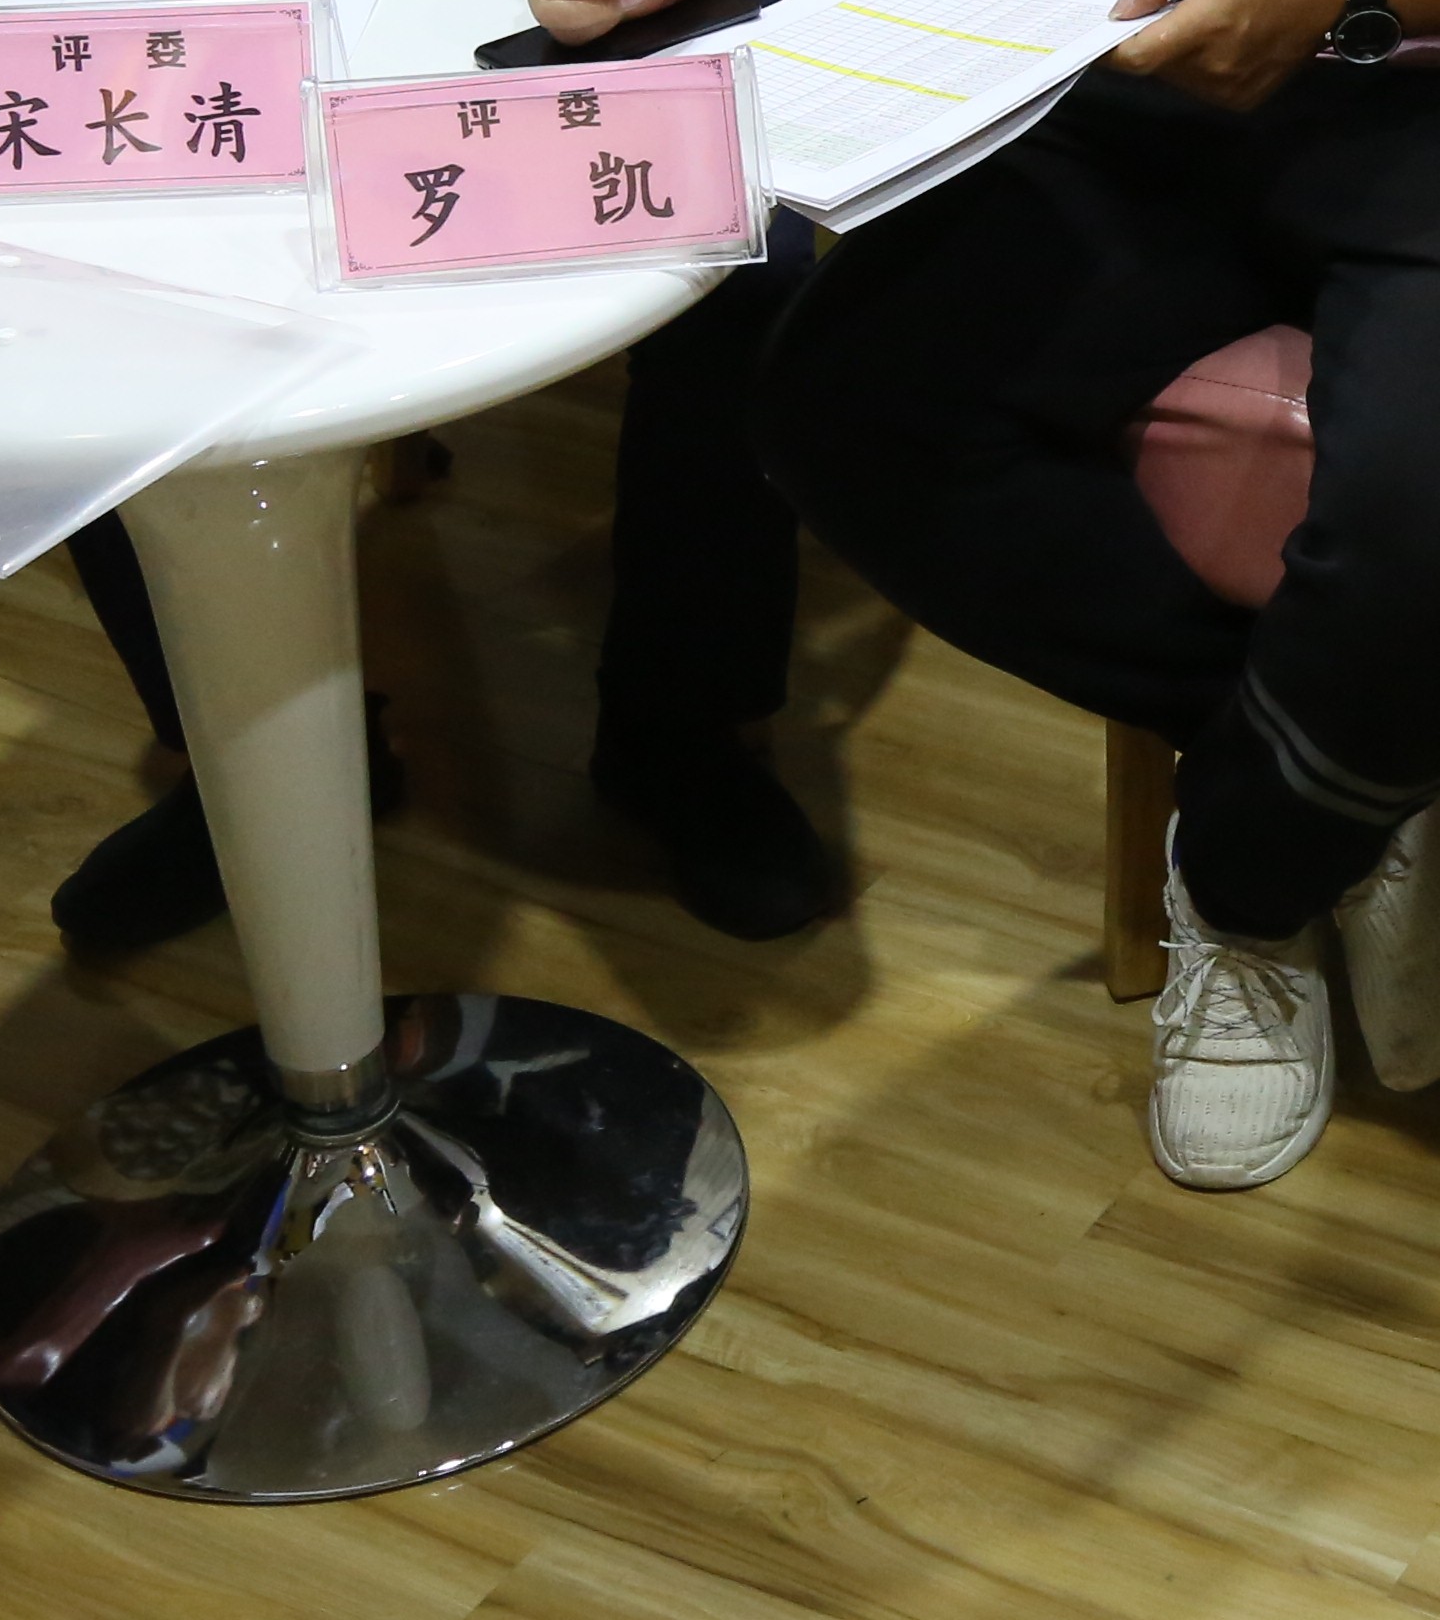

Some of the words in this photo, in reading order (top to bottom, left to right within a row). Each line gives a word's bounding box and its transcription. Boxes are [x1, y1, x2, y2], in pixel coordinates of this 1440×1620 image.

[51, 30, 187, 72] 评委
[457, 87, 601, 140] 评委
[404, 151, 675, 247] 罗凯
